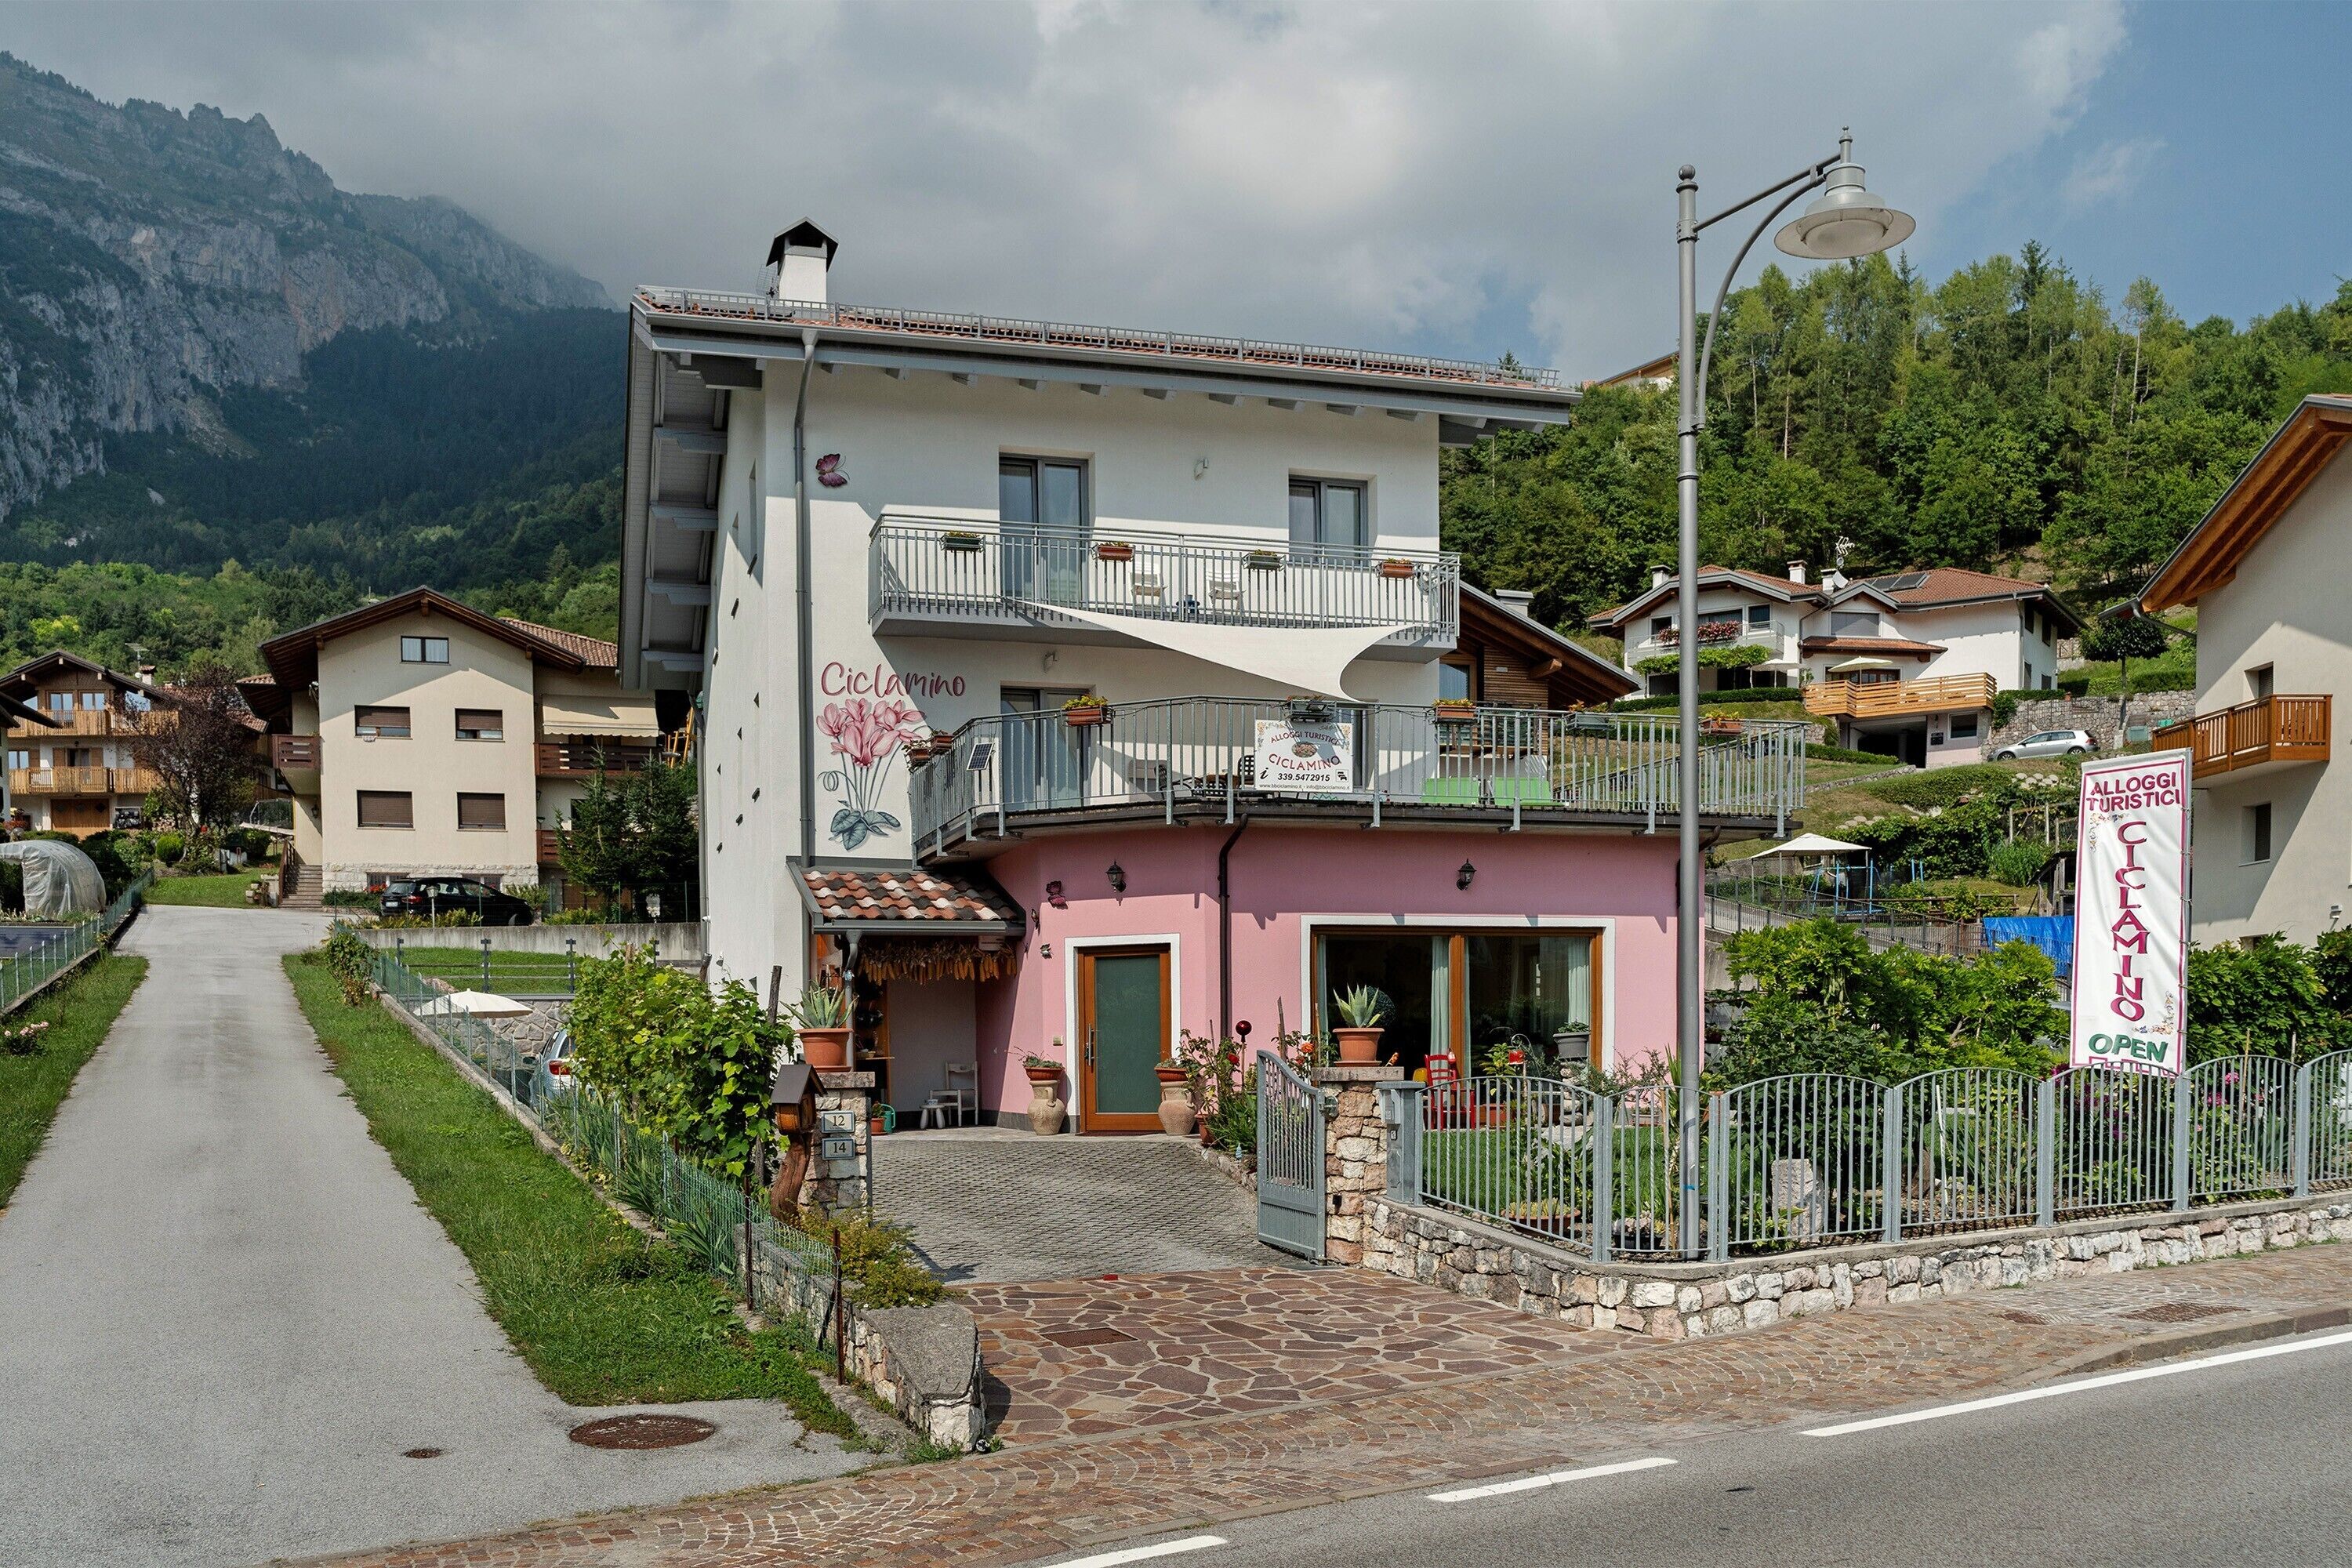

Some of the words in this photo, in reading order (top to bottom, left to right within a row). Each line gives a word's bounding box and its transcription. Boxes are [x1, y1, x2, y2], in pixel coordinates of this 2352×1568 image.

[821, 662, 966, 699] Ciclamino
[1271, 731, 1302, 743] ALLOGGI
[1305, 731, 1339, 746] TURISTICI
[1269, 753, 1341, 771] CICLAMINO
[1277, 772, 1330, 782] 339.5472915
[2090, 771, 2176, 796] ALLOGGI
[2085, 789, 2180, 813] TURISTICI
[2111, 821, 2151, 1022] CICLAMINO
[2088, 1033, 2169, 1063] OPEN
[833, 1115, 845, 1127] 12
[833, 1142, 847, 1153] 14
